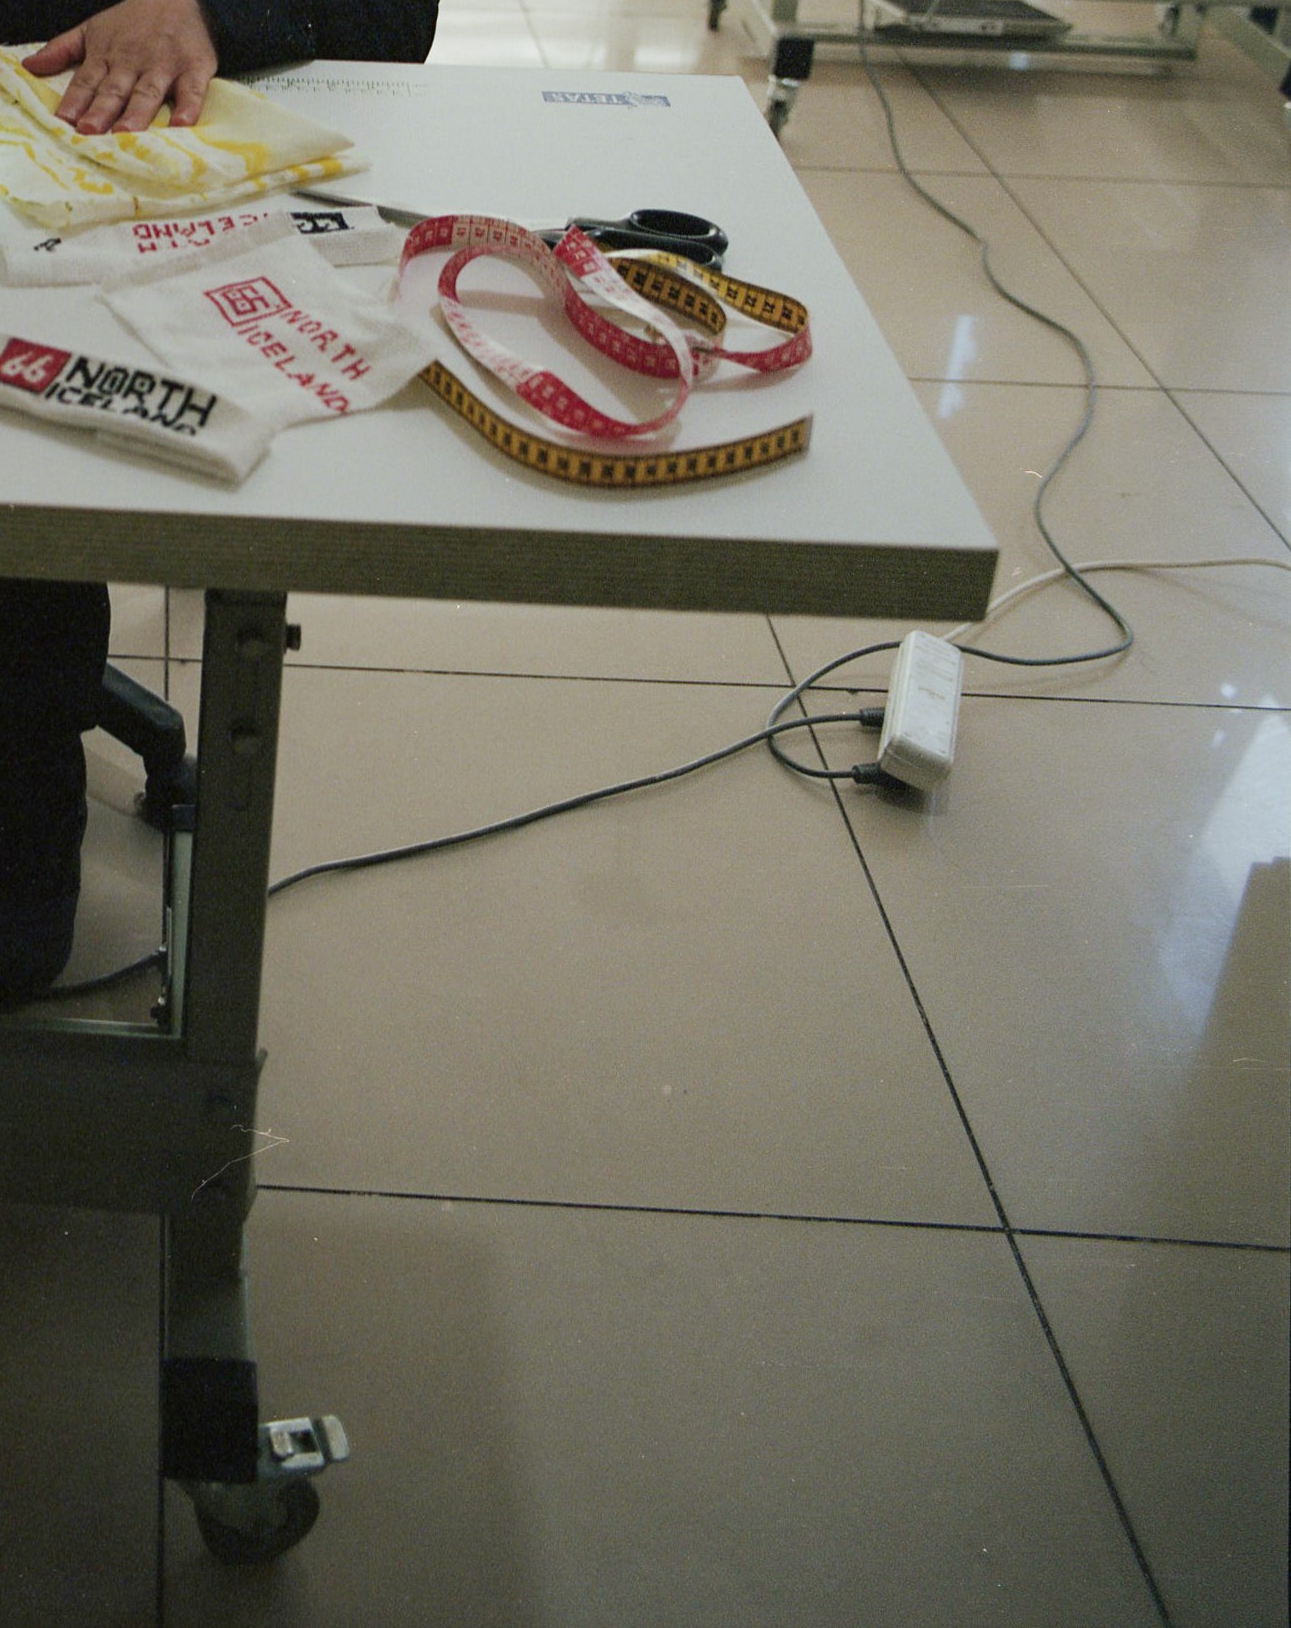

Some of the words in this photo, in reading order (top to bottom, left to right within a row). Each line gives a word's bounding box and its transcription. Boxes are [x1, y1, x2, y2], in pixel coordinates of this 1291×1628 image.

[236, 324, 351, 416] ICELAND
[279, 310, 371, 381] NORTH
[0, 350, 55, 384] 66
[64, 355, 217, 427] NORTH
